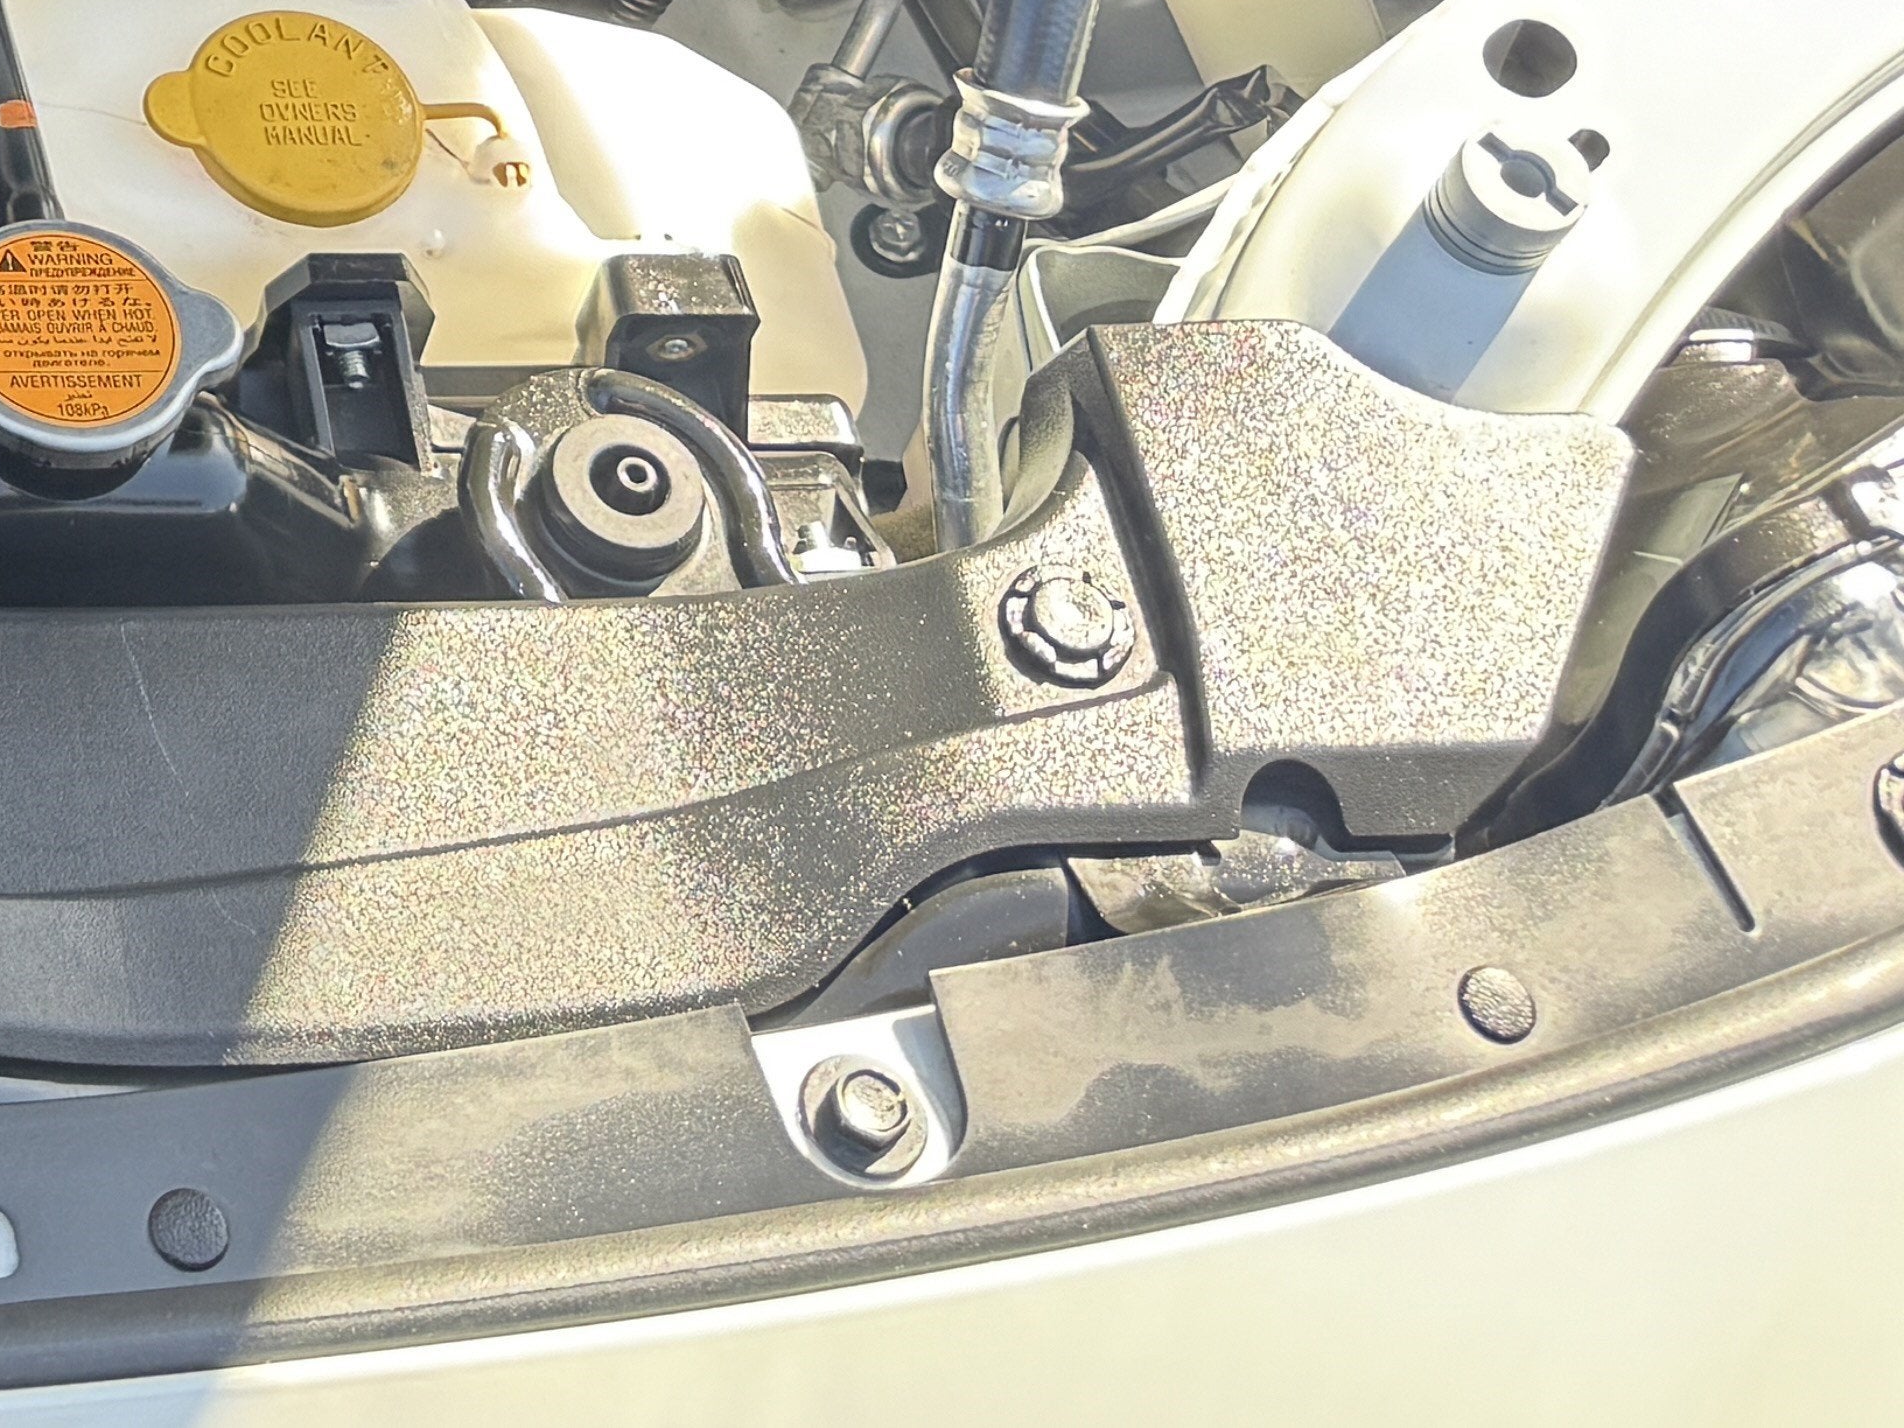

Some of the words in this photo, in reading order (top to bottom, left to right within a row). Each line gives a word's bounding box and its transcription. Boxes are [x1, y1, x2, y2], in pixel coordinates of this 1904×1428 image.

[205, 16, 390, 78] COOLANT
[271, 78, 318, 99] SEE
[263, 125, 363, 146] MANUAL
[27, 252, 113, 266] WARNING
[27, 309, 66, 321] OPEN
[72, 309, 117, 321] WHEN
[46, 321, 93, 333] OUVRIR
[81, 349, 99, 357] на
[10, 374, 143, 388] AVERTISSEMENT
